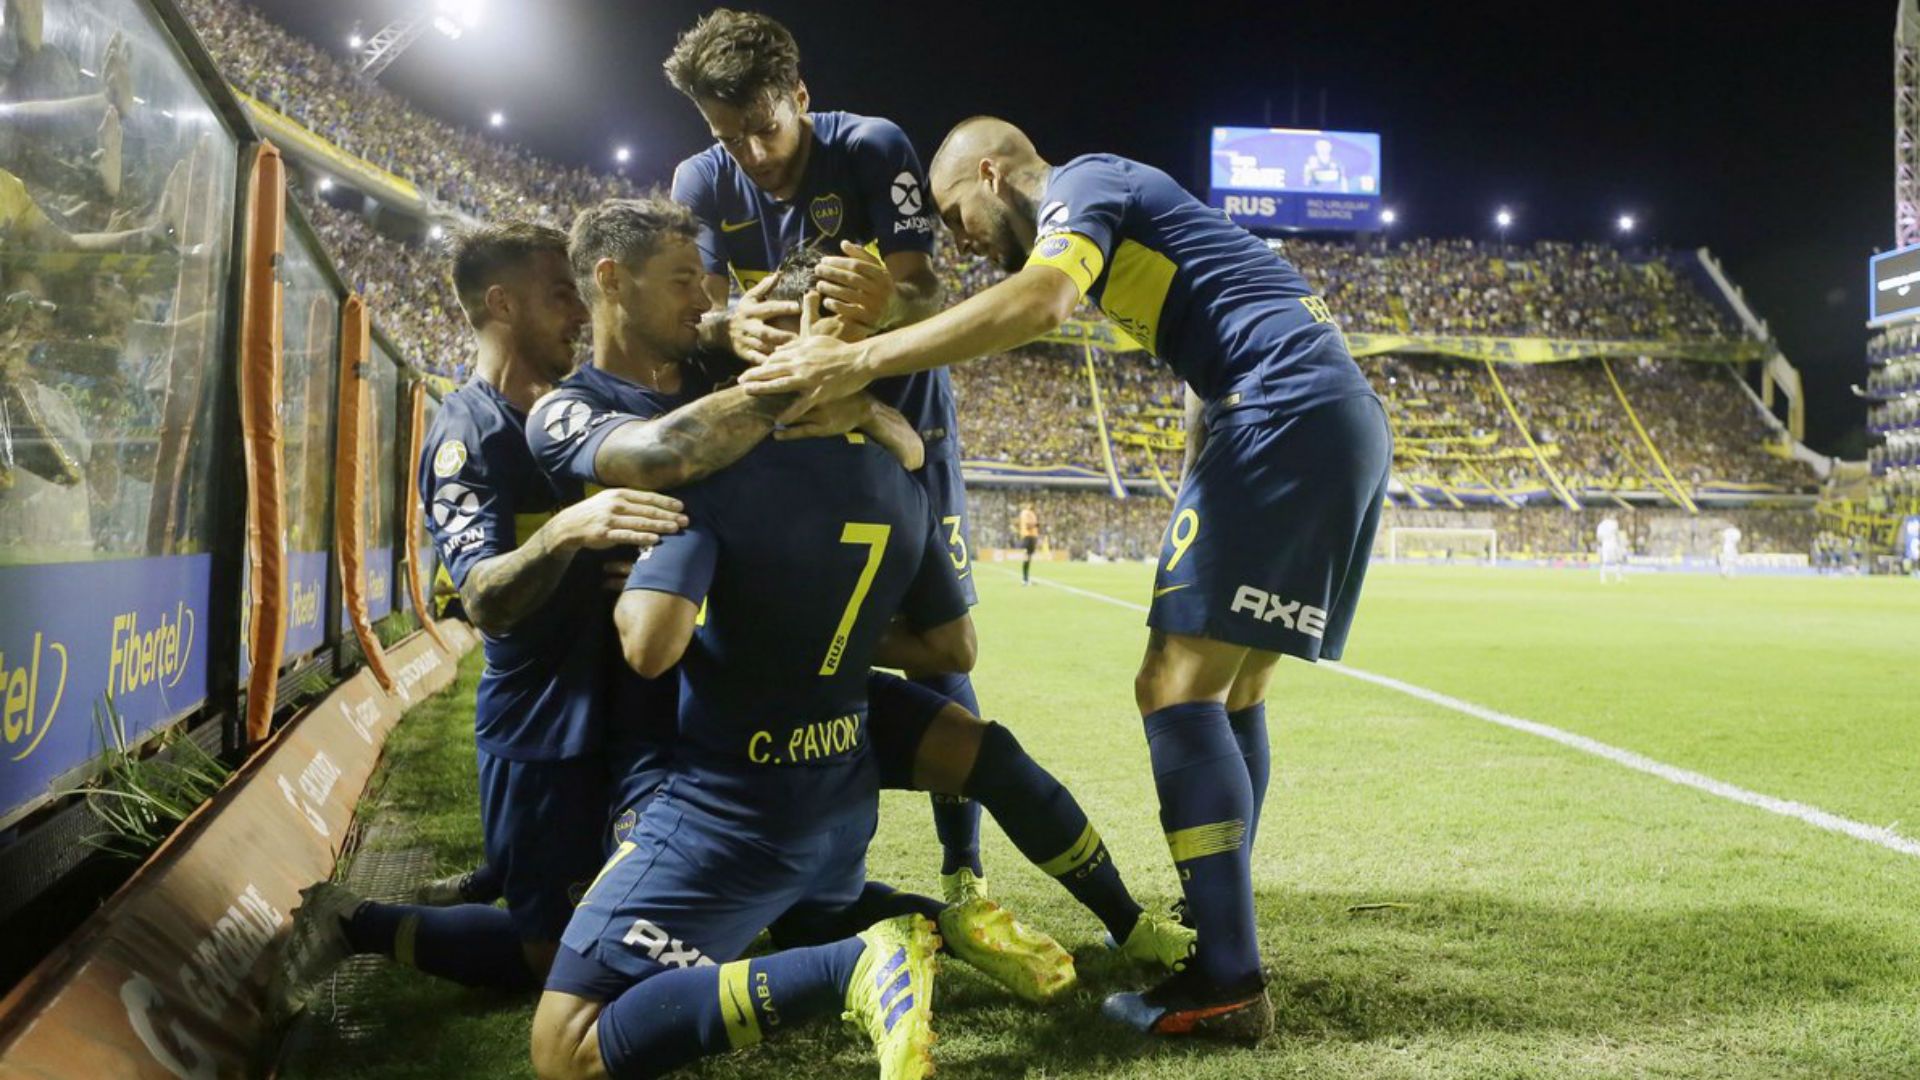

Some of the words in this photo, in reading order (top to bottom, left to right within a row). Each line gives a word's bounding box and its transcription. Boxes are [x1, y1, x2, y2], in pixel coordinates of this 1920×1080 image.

[1224, 195, 1277, 217] RUS
[942, 515, 968, 570] 3
[1165, 508, 1200, 572] 9
[818, 522, 892, 676] 7
[1230, 585, 1328, 640] AXE
[107, 600, 183, 700] Fibertel
[827, 633, 846, 669] RUS
[748, 731, 781, 764] C.
[788, 714, 860, 762] PAVON
[622, 919, 718, 969] AX
[756, 972, 780, 1026] CABJ
